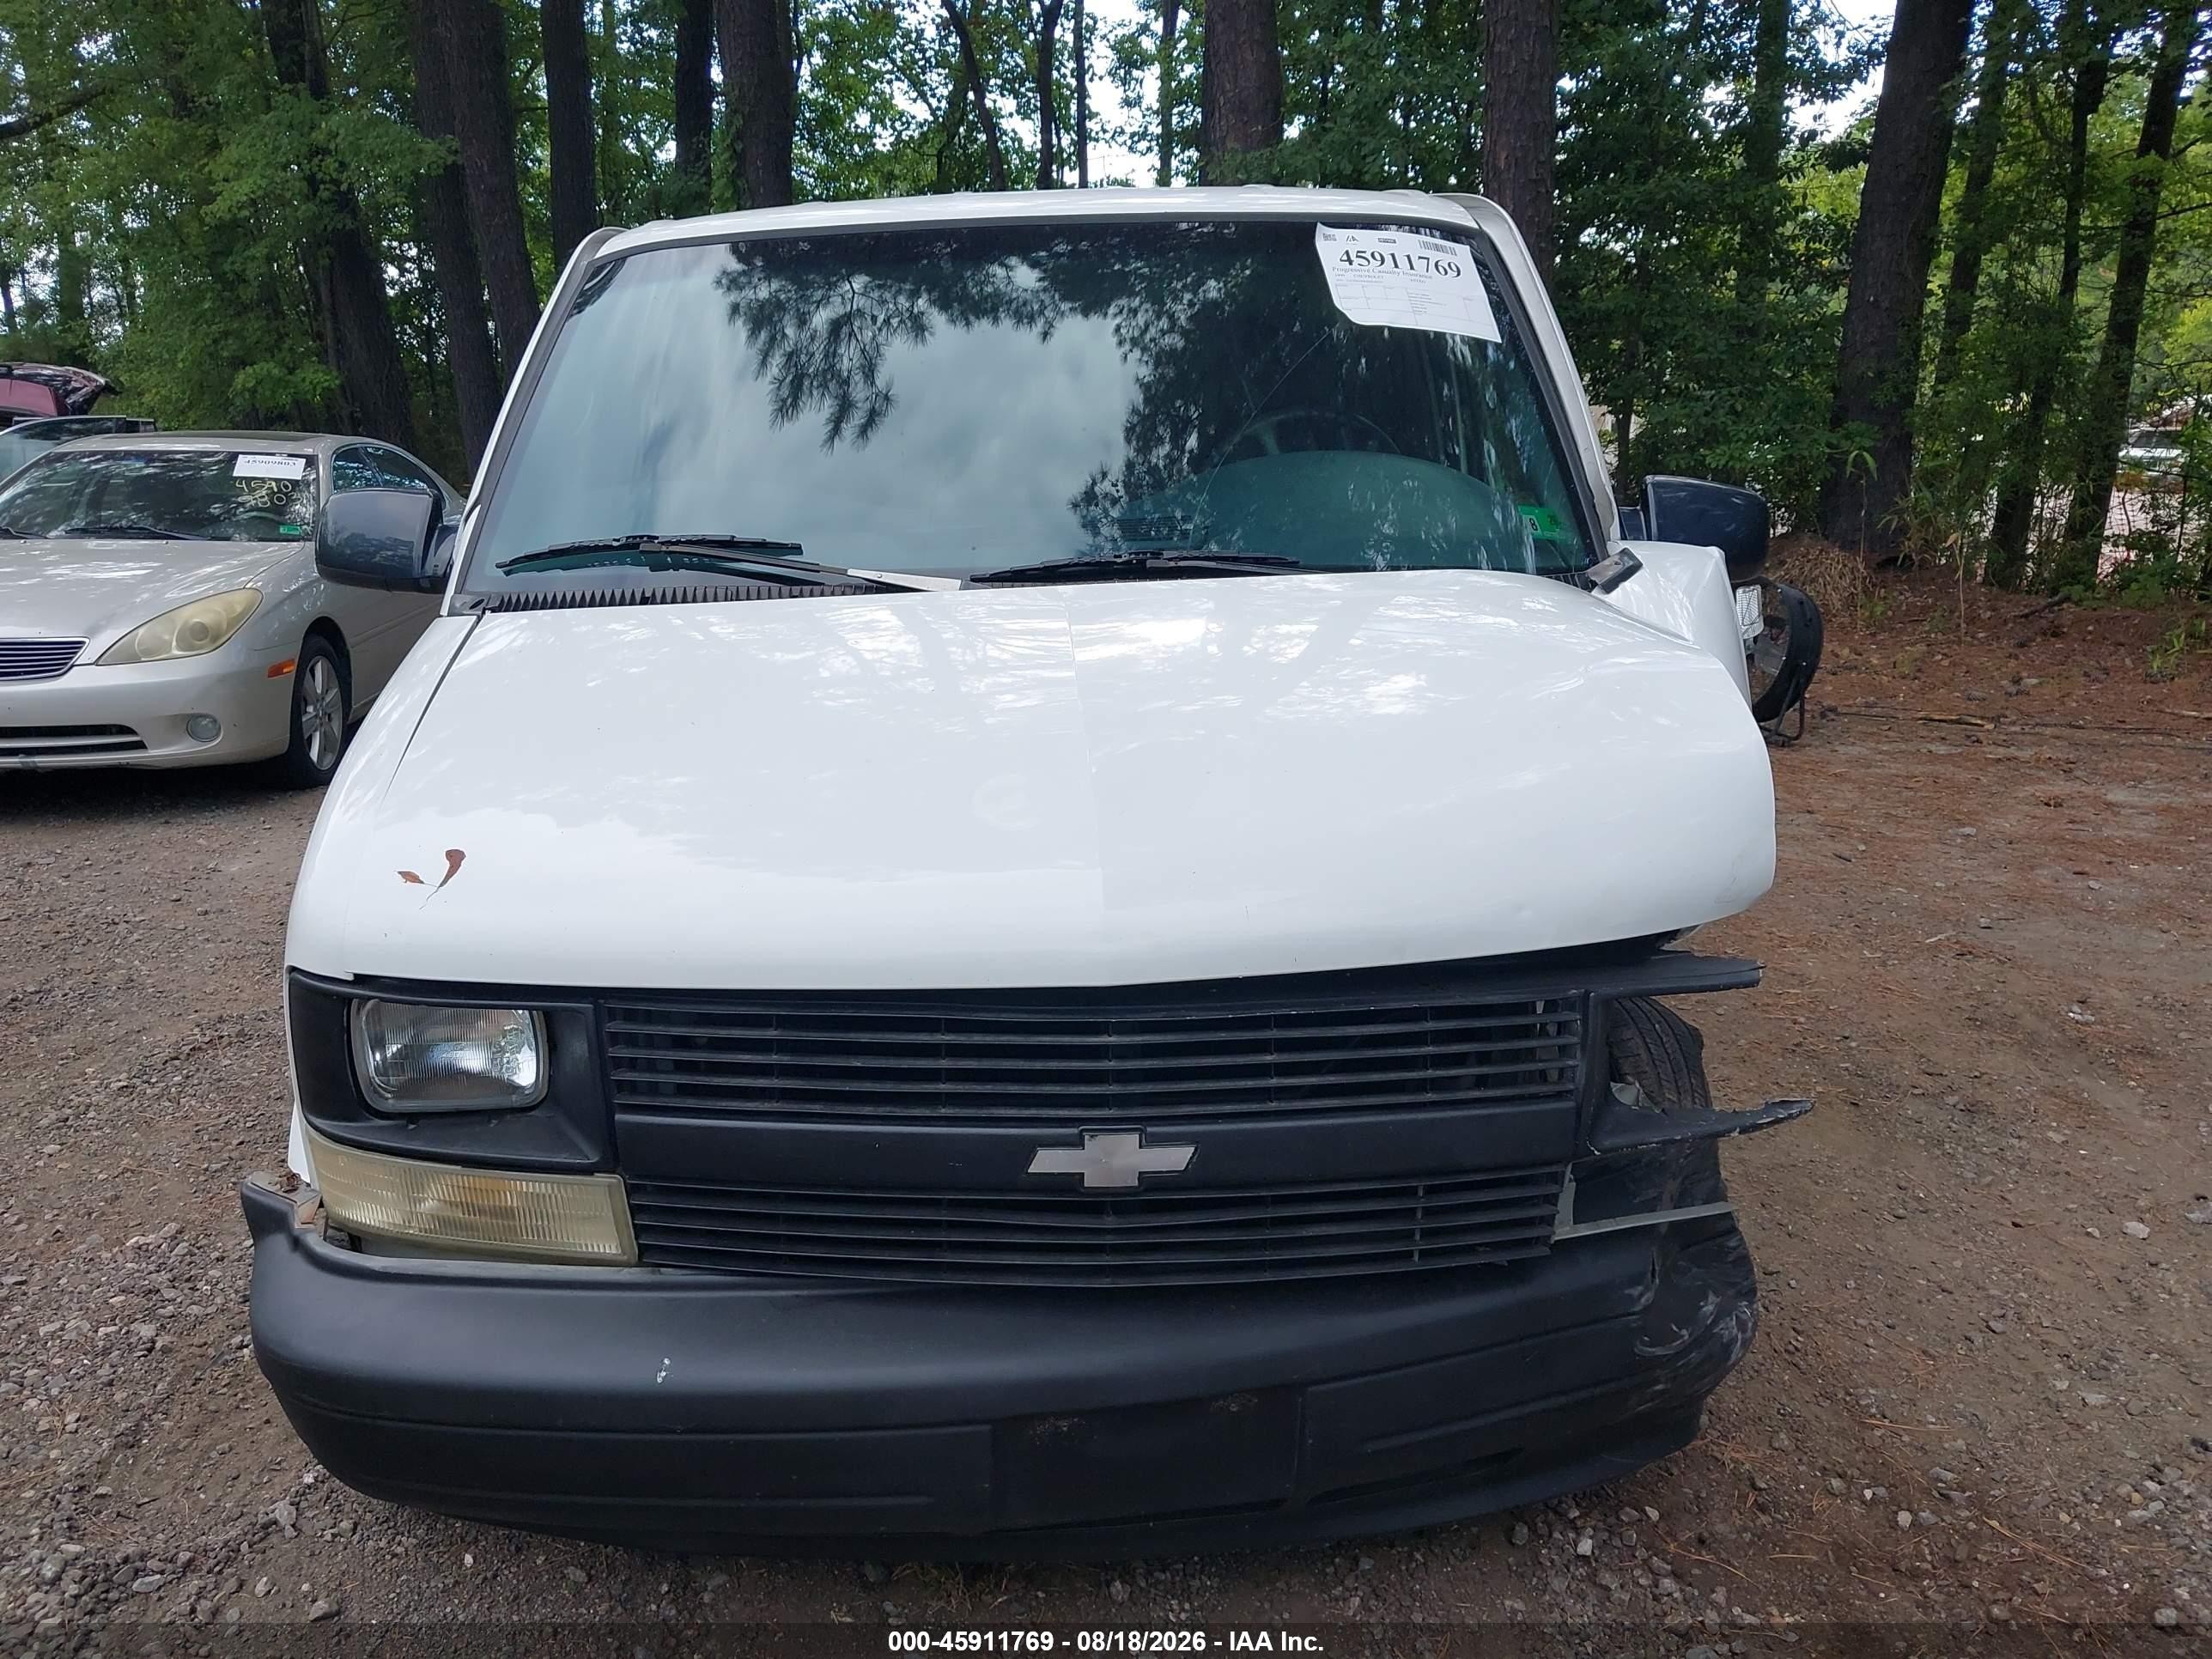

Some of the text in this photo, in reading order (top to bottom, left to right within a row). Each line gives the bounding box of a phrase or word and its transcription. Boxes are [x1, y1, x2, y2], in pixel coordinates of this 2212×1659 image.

[1339, 249, 1462, 278] 45911769
[1372, 268, 1401, 276] Casualty
[1402, 270, 1433, 280] Insurance
[236, 479, 292, 492] 4590
[1528, 518, 1538, 532] 8
